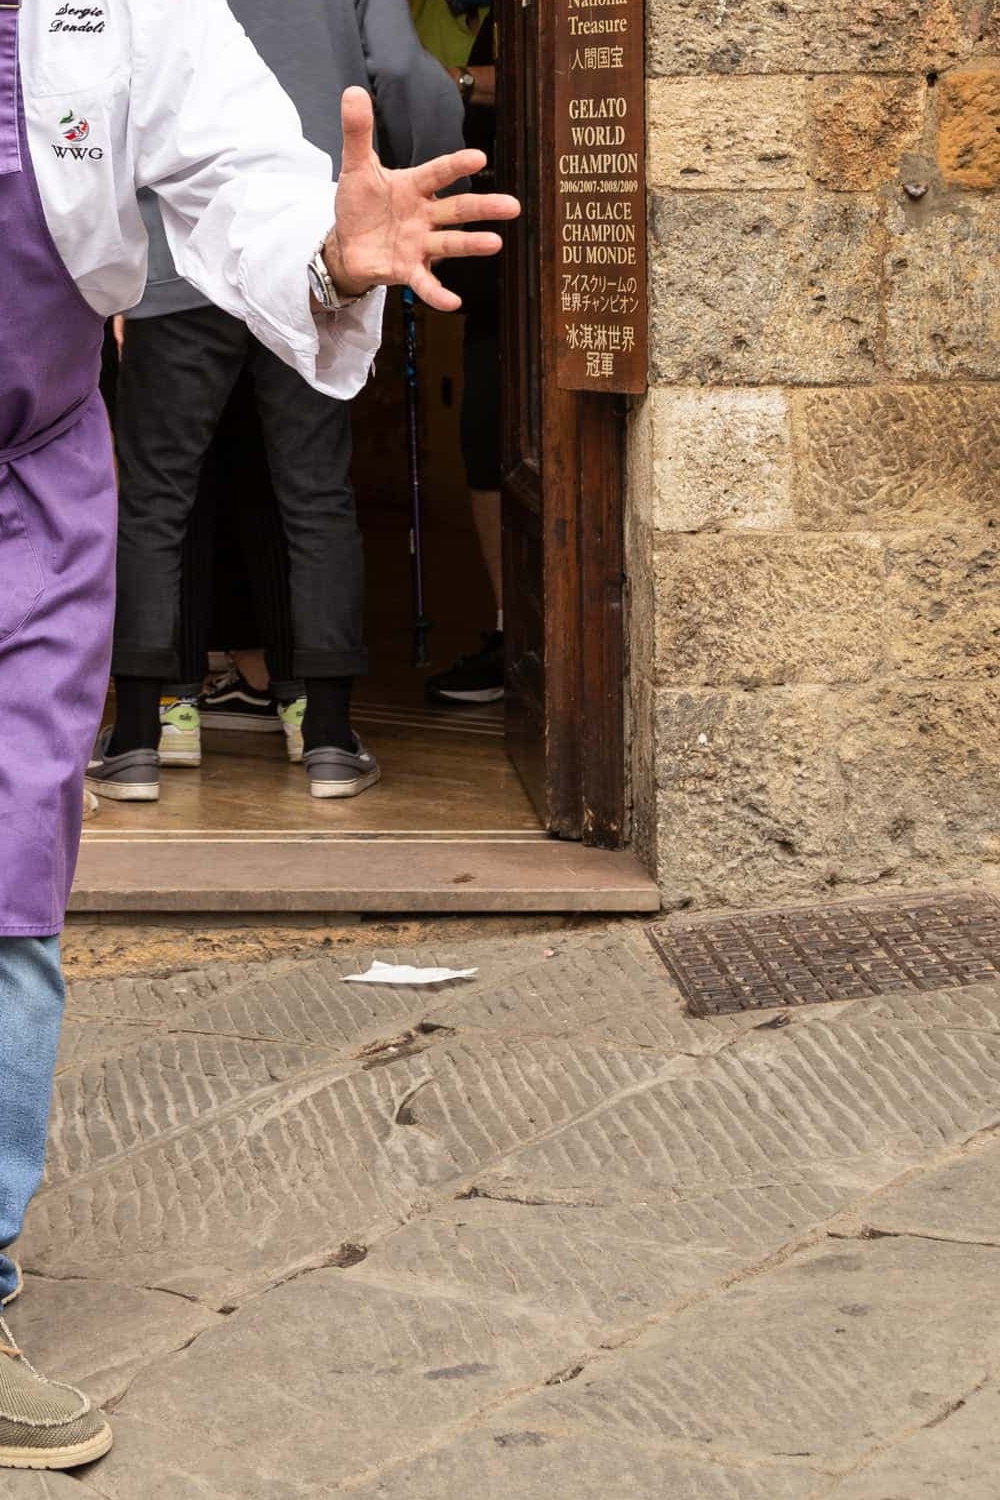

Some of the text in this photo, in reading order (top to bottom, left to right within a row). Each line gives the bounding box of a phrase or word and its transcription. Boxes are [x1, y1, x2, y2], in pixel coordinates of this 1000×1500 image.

[55, 3, 105, 20] Sergio
[48, 19, 106, 34] Dondoli
[568, 16, 628, 36] Treasure
[570, 46, 624, 70] 人間国宝
[569, 97, 627, 119] GELATO
[571, 126, 626, 147] WORLD
[51, 144, 104, 161] WWG
[559, 153, 638, 175] CHAMPION
[559, 180, 639, 193] 2006/2007-2008/2009
[565, 202, 632, 220] LA GLACE
[562, 224, 636, 243] CHAMPION
[562, 246, 637, 265] DU MONDE
[561, 274, 638, 294] アイスクリームの
[564, 323, 636, 352] 冰淇淋世界
[585, 351, 614, 378] 冠軍
